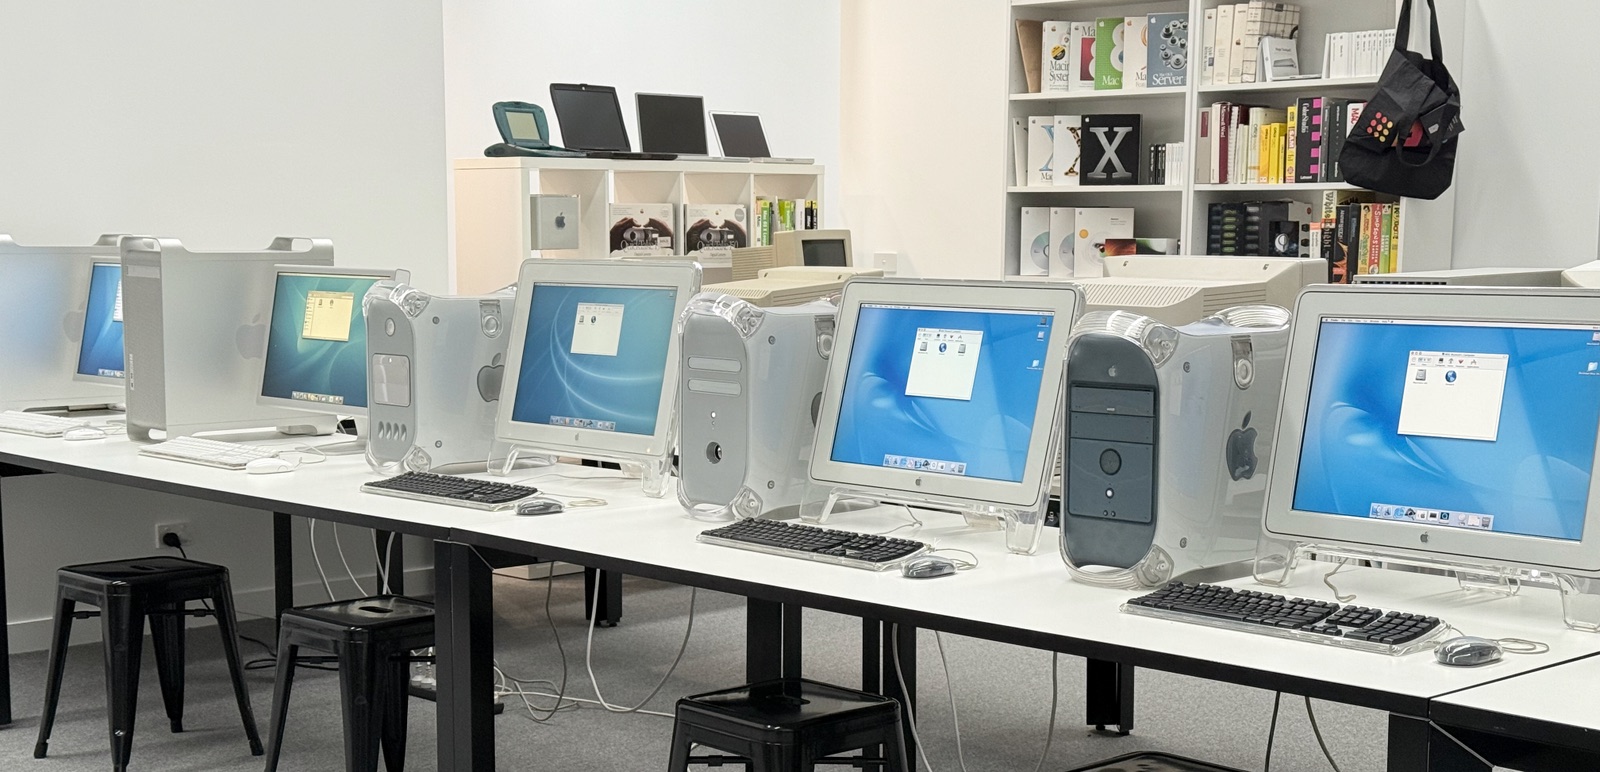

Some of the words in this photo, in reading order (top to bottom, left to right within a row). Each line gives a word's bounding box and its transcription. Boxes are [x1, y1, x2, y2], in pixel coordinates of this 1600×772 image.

[1081, 26, 1095, 37] Ma
[1102, 74, 1120, 86] Mac
[1152, 74, 1184, 86] Server
[1086, 126, 1132, 178] X
[1372, 210, 1381, 244] SIMPSONS
